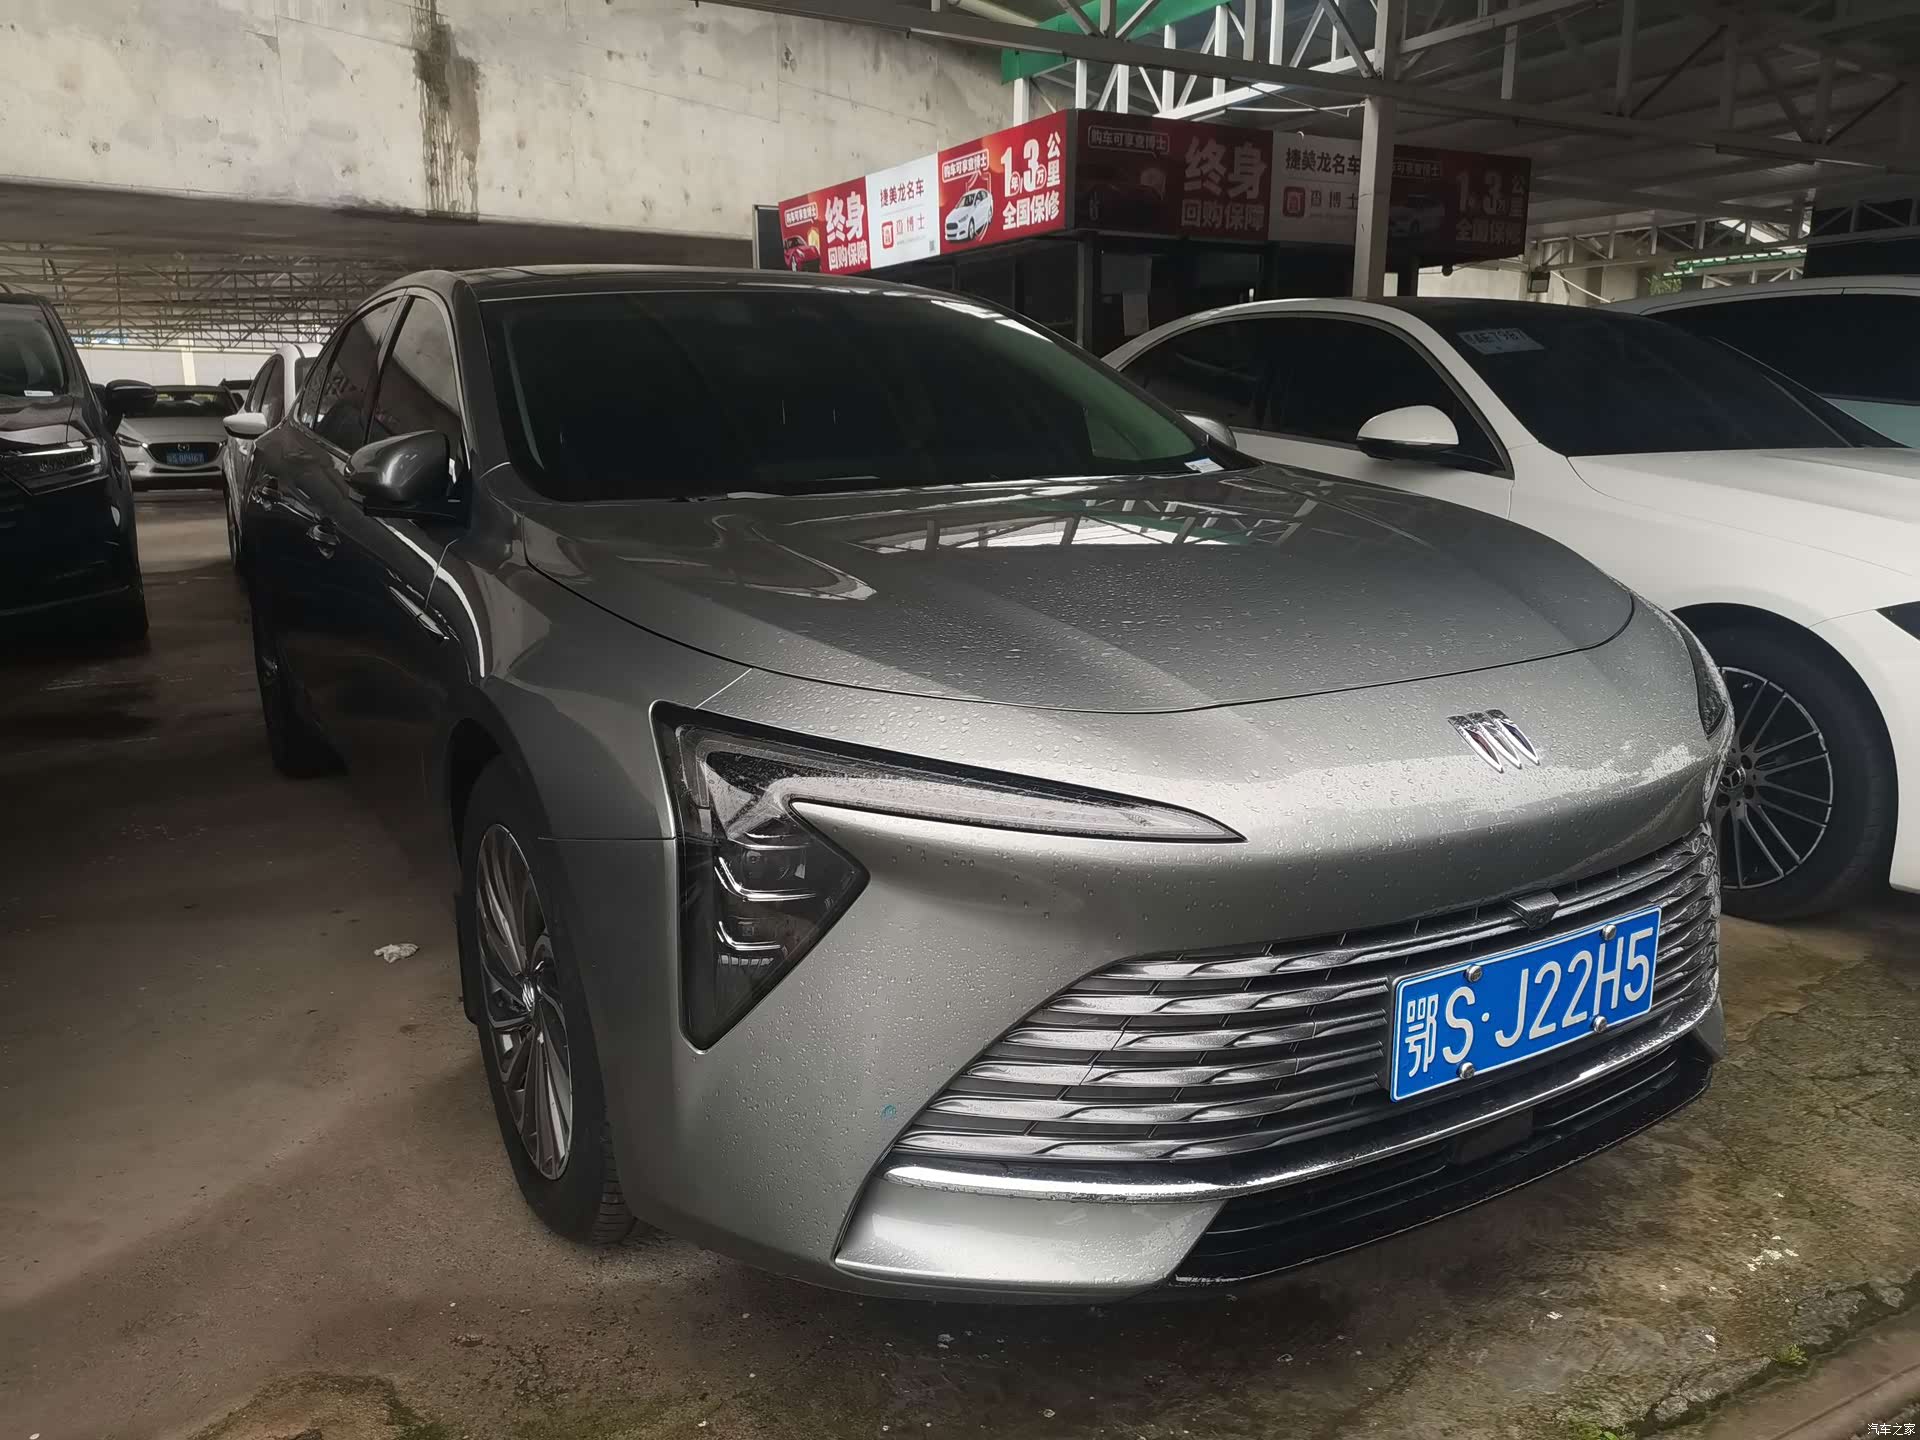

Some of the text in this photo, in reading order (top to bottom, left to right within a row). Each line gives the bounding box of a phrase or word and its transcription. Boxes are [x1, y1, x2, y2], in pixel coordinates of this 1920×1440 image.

[1184, 136, 1267, 198] 终身
[1286, 148, 1360, 175] 捷美龙名车
[880, 177, 924, 208] 捷美龙名车
[1003, 190, 1059, 230] 全国保修
[825, 191, 864, 244] 终身
[1181, 200, 1265, 231] 回购保障
[828, 240, 868, 271] 回购保障
[1404, 927, 1654, 1078] 鄂S·J22H5
